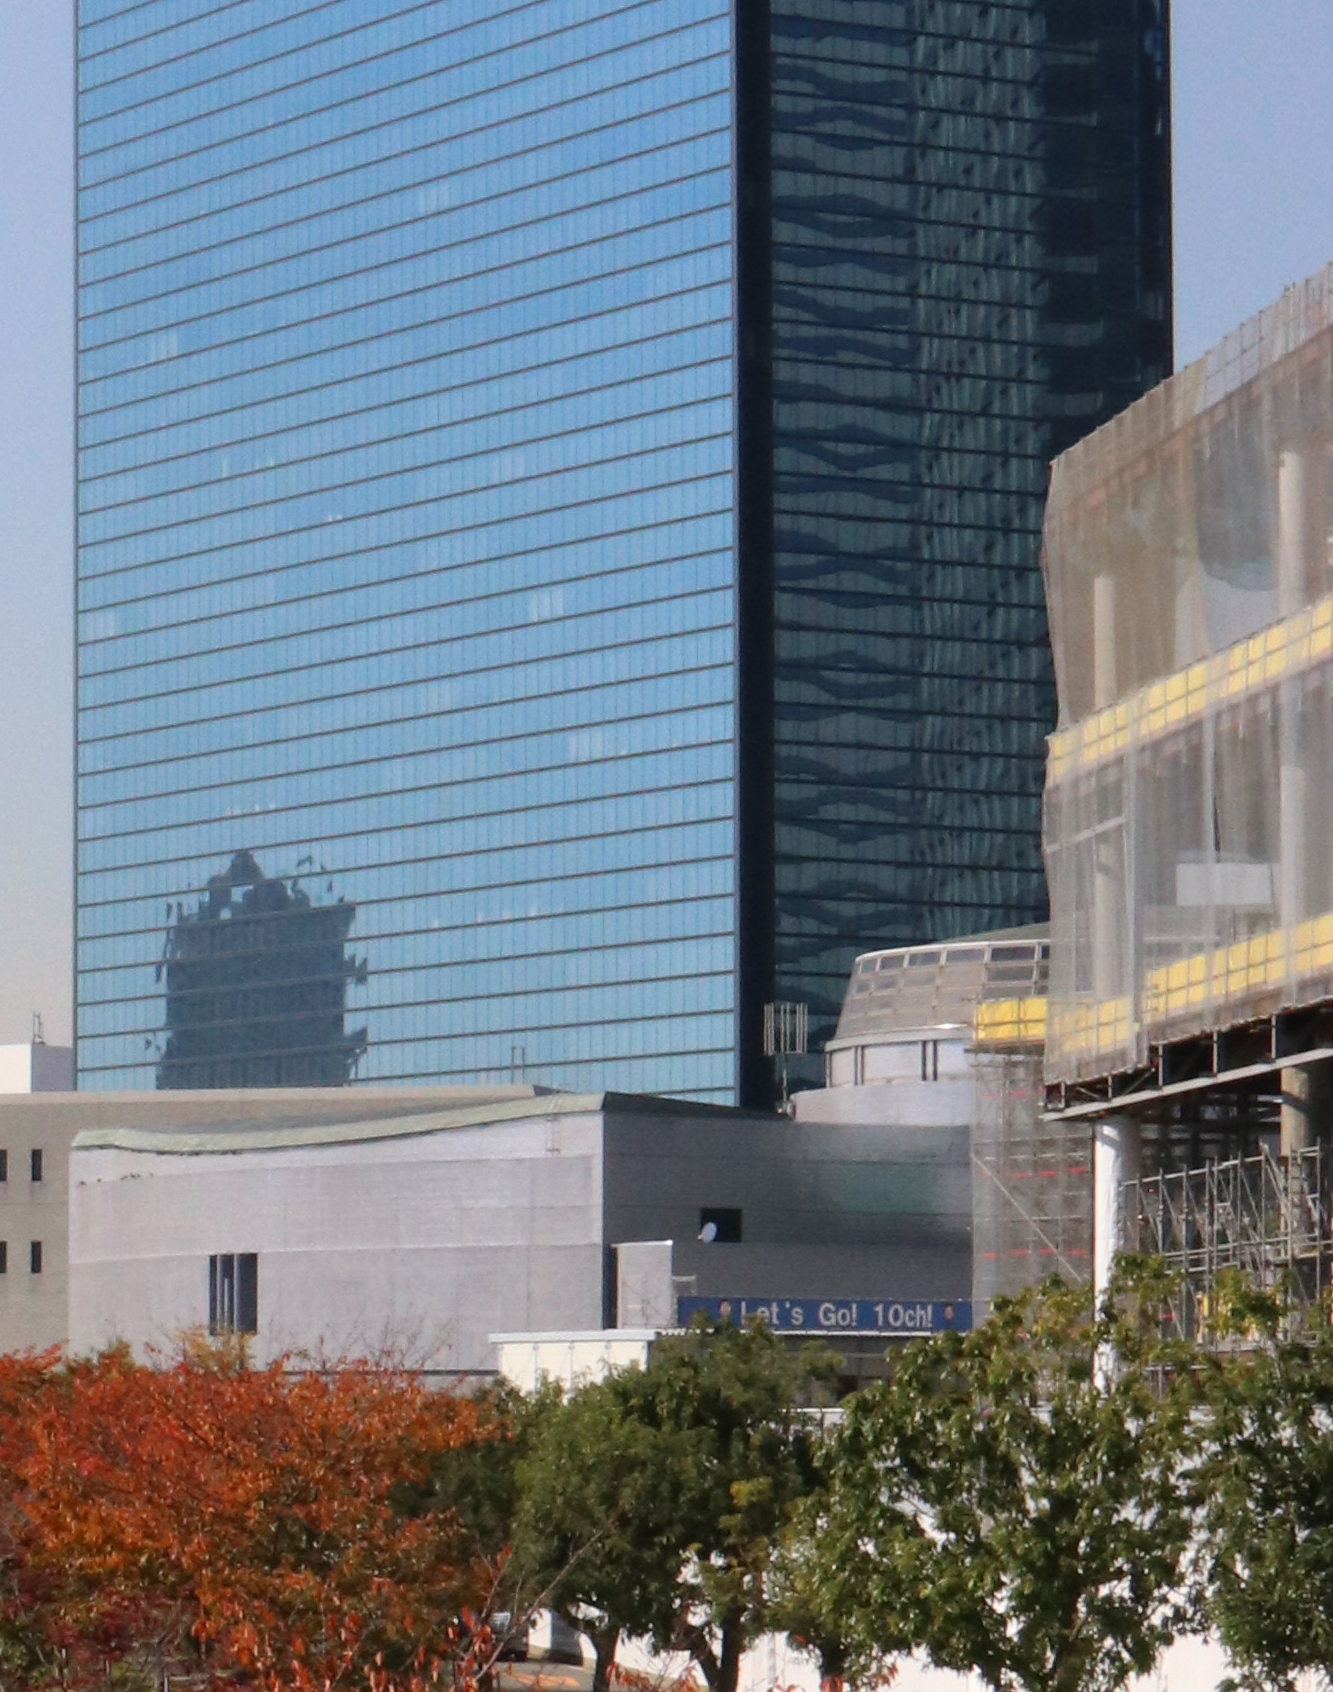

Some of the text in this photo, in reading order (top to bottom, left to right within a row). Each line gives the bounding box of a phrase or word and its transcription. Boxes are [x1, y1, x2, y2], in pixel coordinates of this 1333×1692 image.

[740, 1300, 933, 1327] Let's Go! 10ch!
